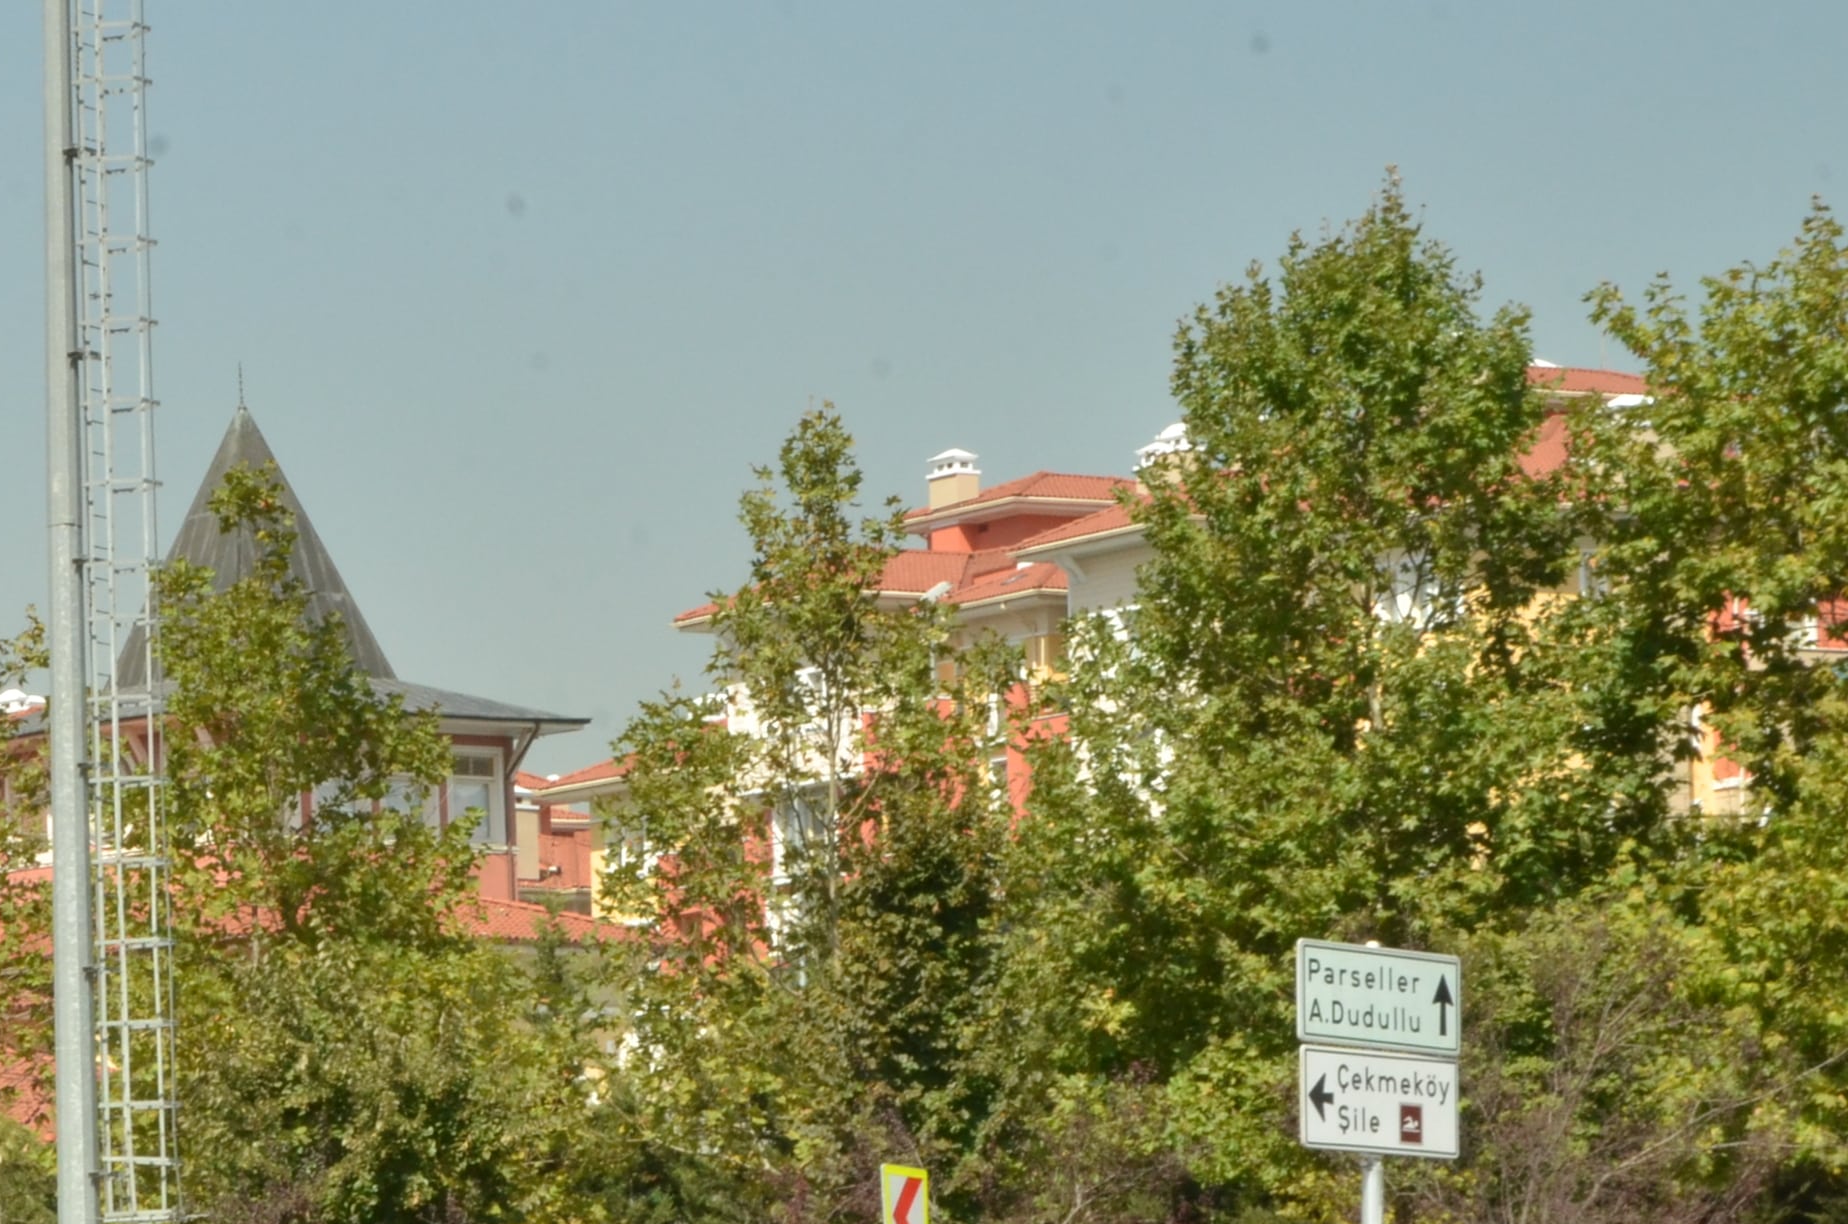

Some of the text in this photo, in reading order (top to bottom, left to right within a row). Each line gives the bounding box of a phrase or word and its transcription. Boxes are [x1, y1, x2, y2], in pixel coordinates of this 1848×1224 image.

[1308, 958, 1420, 994] Parseller
[1309, 997, 1421, 1033] A.Dudullu
[1337, 1063, 1450, 1105] Çekmeköy
[1338, 1105, 1380, 1134] Şile
